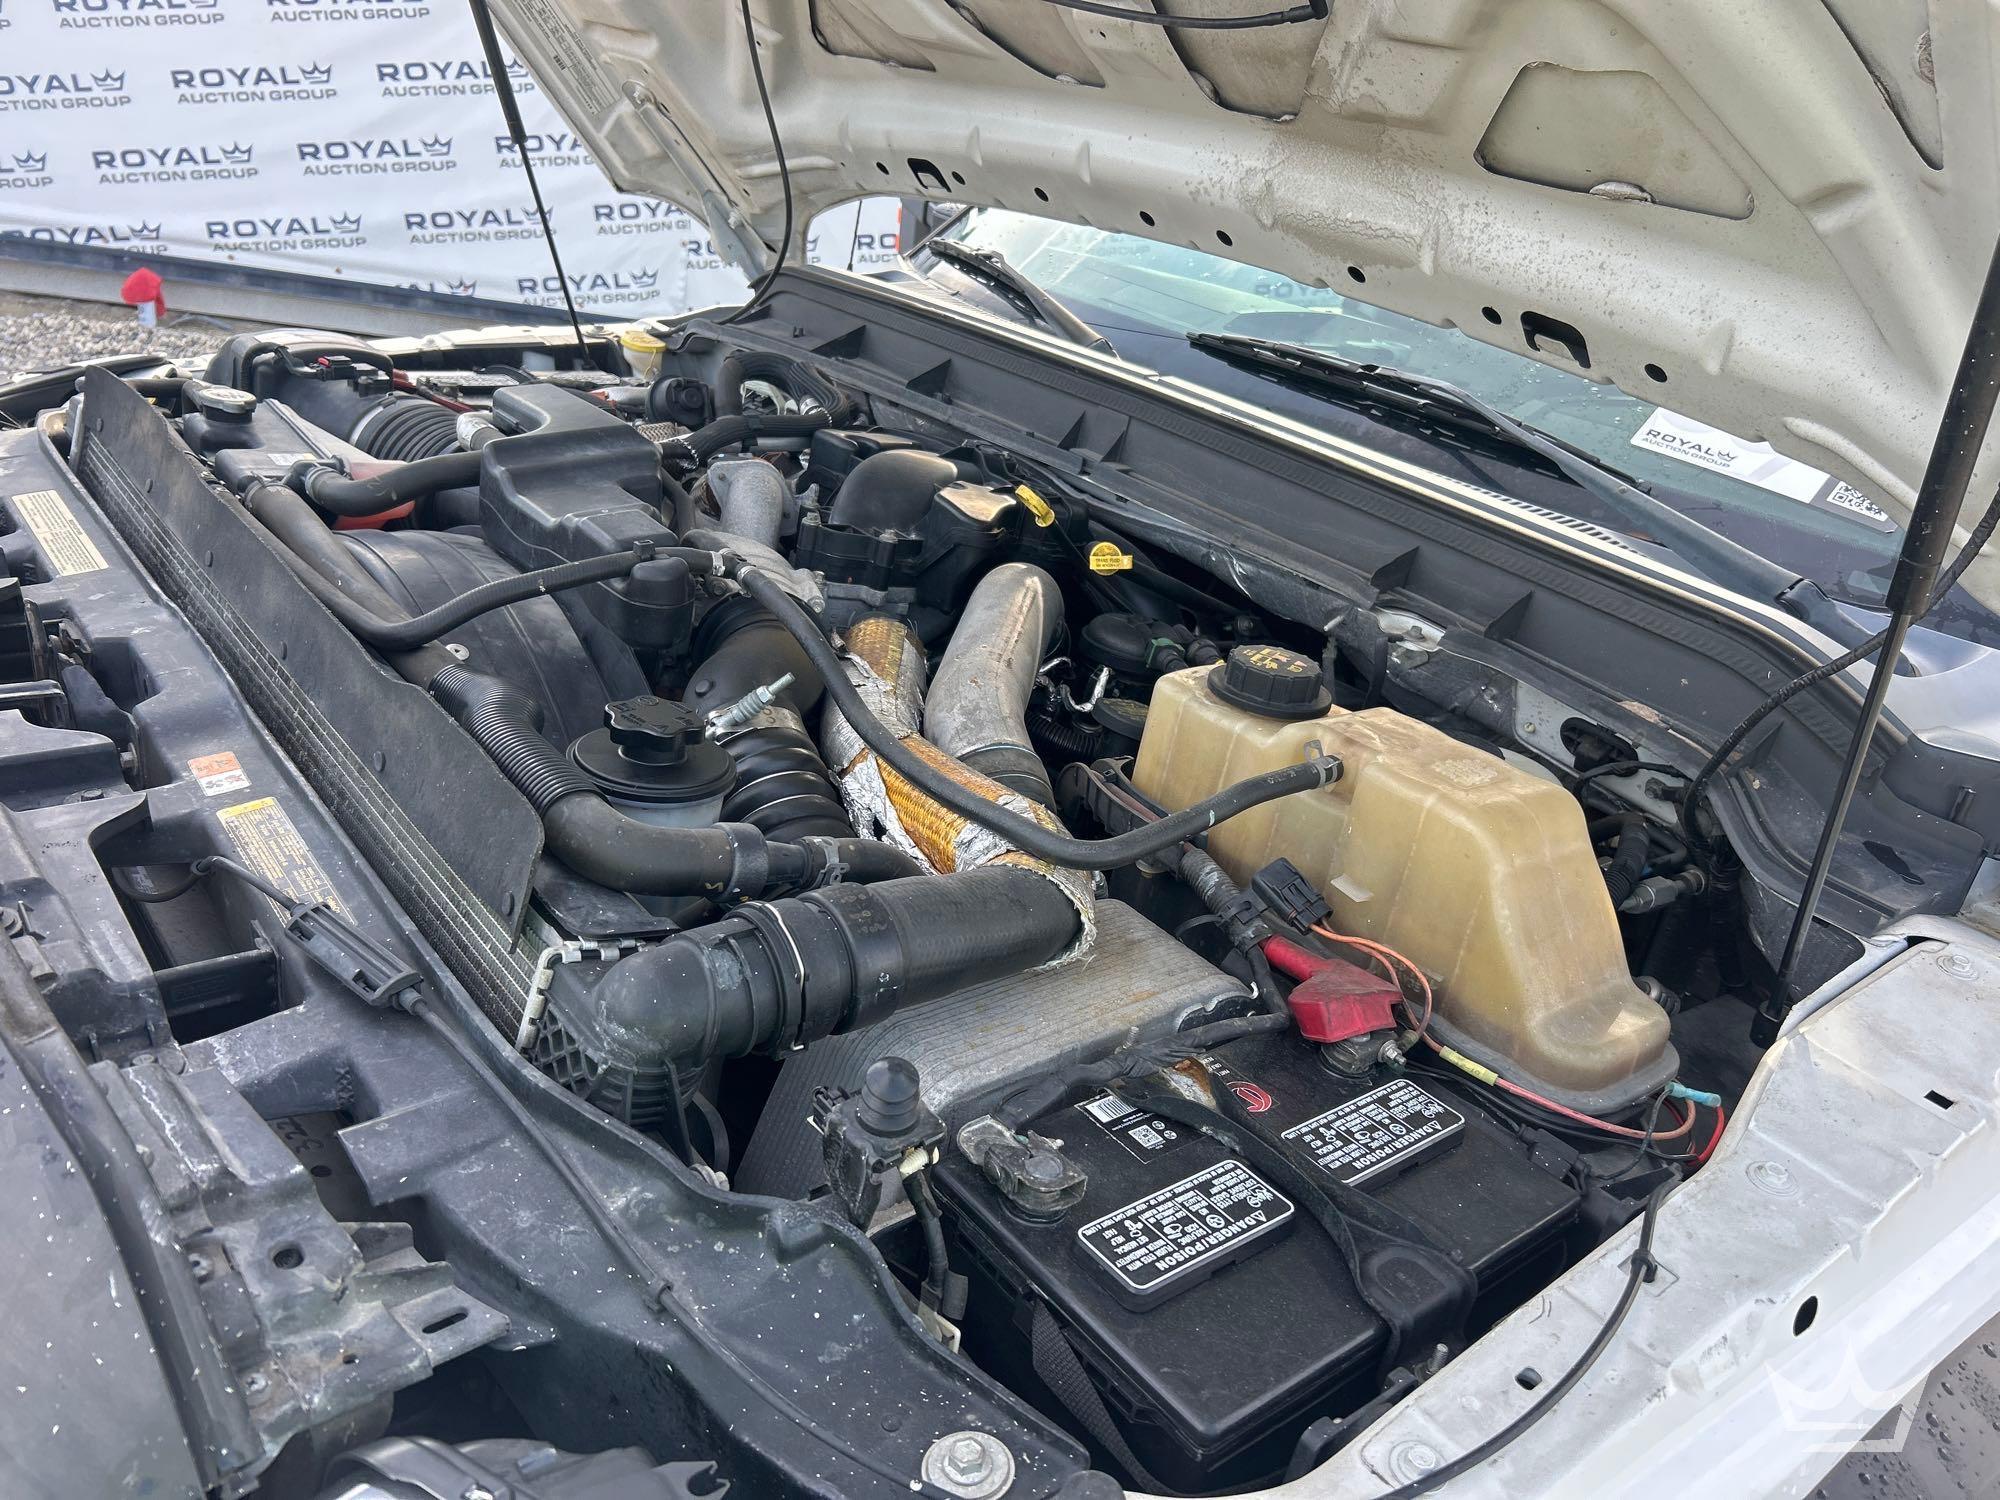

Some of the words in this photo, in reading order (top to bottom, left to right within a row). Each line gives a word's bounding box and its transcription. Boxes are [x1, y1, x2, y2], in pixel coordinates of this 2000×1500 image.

[59, 16, 150, 29] AUCTION
[154, 13, 225, 26] GROUP
[271, 10, 358, 22] AUCTION
[363, 7, 430, 20] GROUP
[170, 66, 300, 89] ROYAL
[376, 60, 493, 82] ROYAL
[0, 73, 93, 94] OYAL
[381, 84, 466, 98] AUCTION
[470, 82, 535, 95] GRUP
[0, 99, 57, 111] CTION
[61, 95, 131, 109] GROUP
[177, 90, 265, 104] AUCTION
[269, 88, 337, 101] GROUP
[92, 147, 221, 169] ROYAL
[297, 139, 422, 161] ROYAL
[99, 171, 186, 184] AUCTION
[191, 167, 259, 180] GROUP
[303, 162, 388, 176] AUCTION
[391, 160, 457, 173] GROUP
[0, 176, 53, 189] ROUP
[404, 207, 524, 230] ROYAL
[594, 201, 685, 221] ROYA
[205, 216, 331, 240] ROYAL
[410, 229, 490, 245] AUCTION
[598, 222, 673, 235] AUCTION
[212, 238, 297, 252] AUCTION
[301, 236, 367, 250] GROUP
[518, 272, 631, 295] ROYAL
[602, 289, 661, 303] GROUP
[1641, 437, 1690, 456] AUCTION
[1691, 452, 1731, 468] GROUP
[1646, 429, 1715, 456] ROYAL
[1353, 1126, 1433, 1169] DANGER/POISON
[1156, 1217, 1256, 1270] DANGER/POISON
